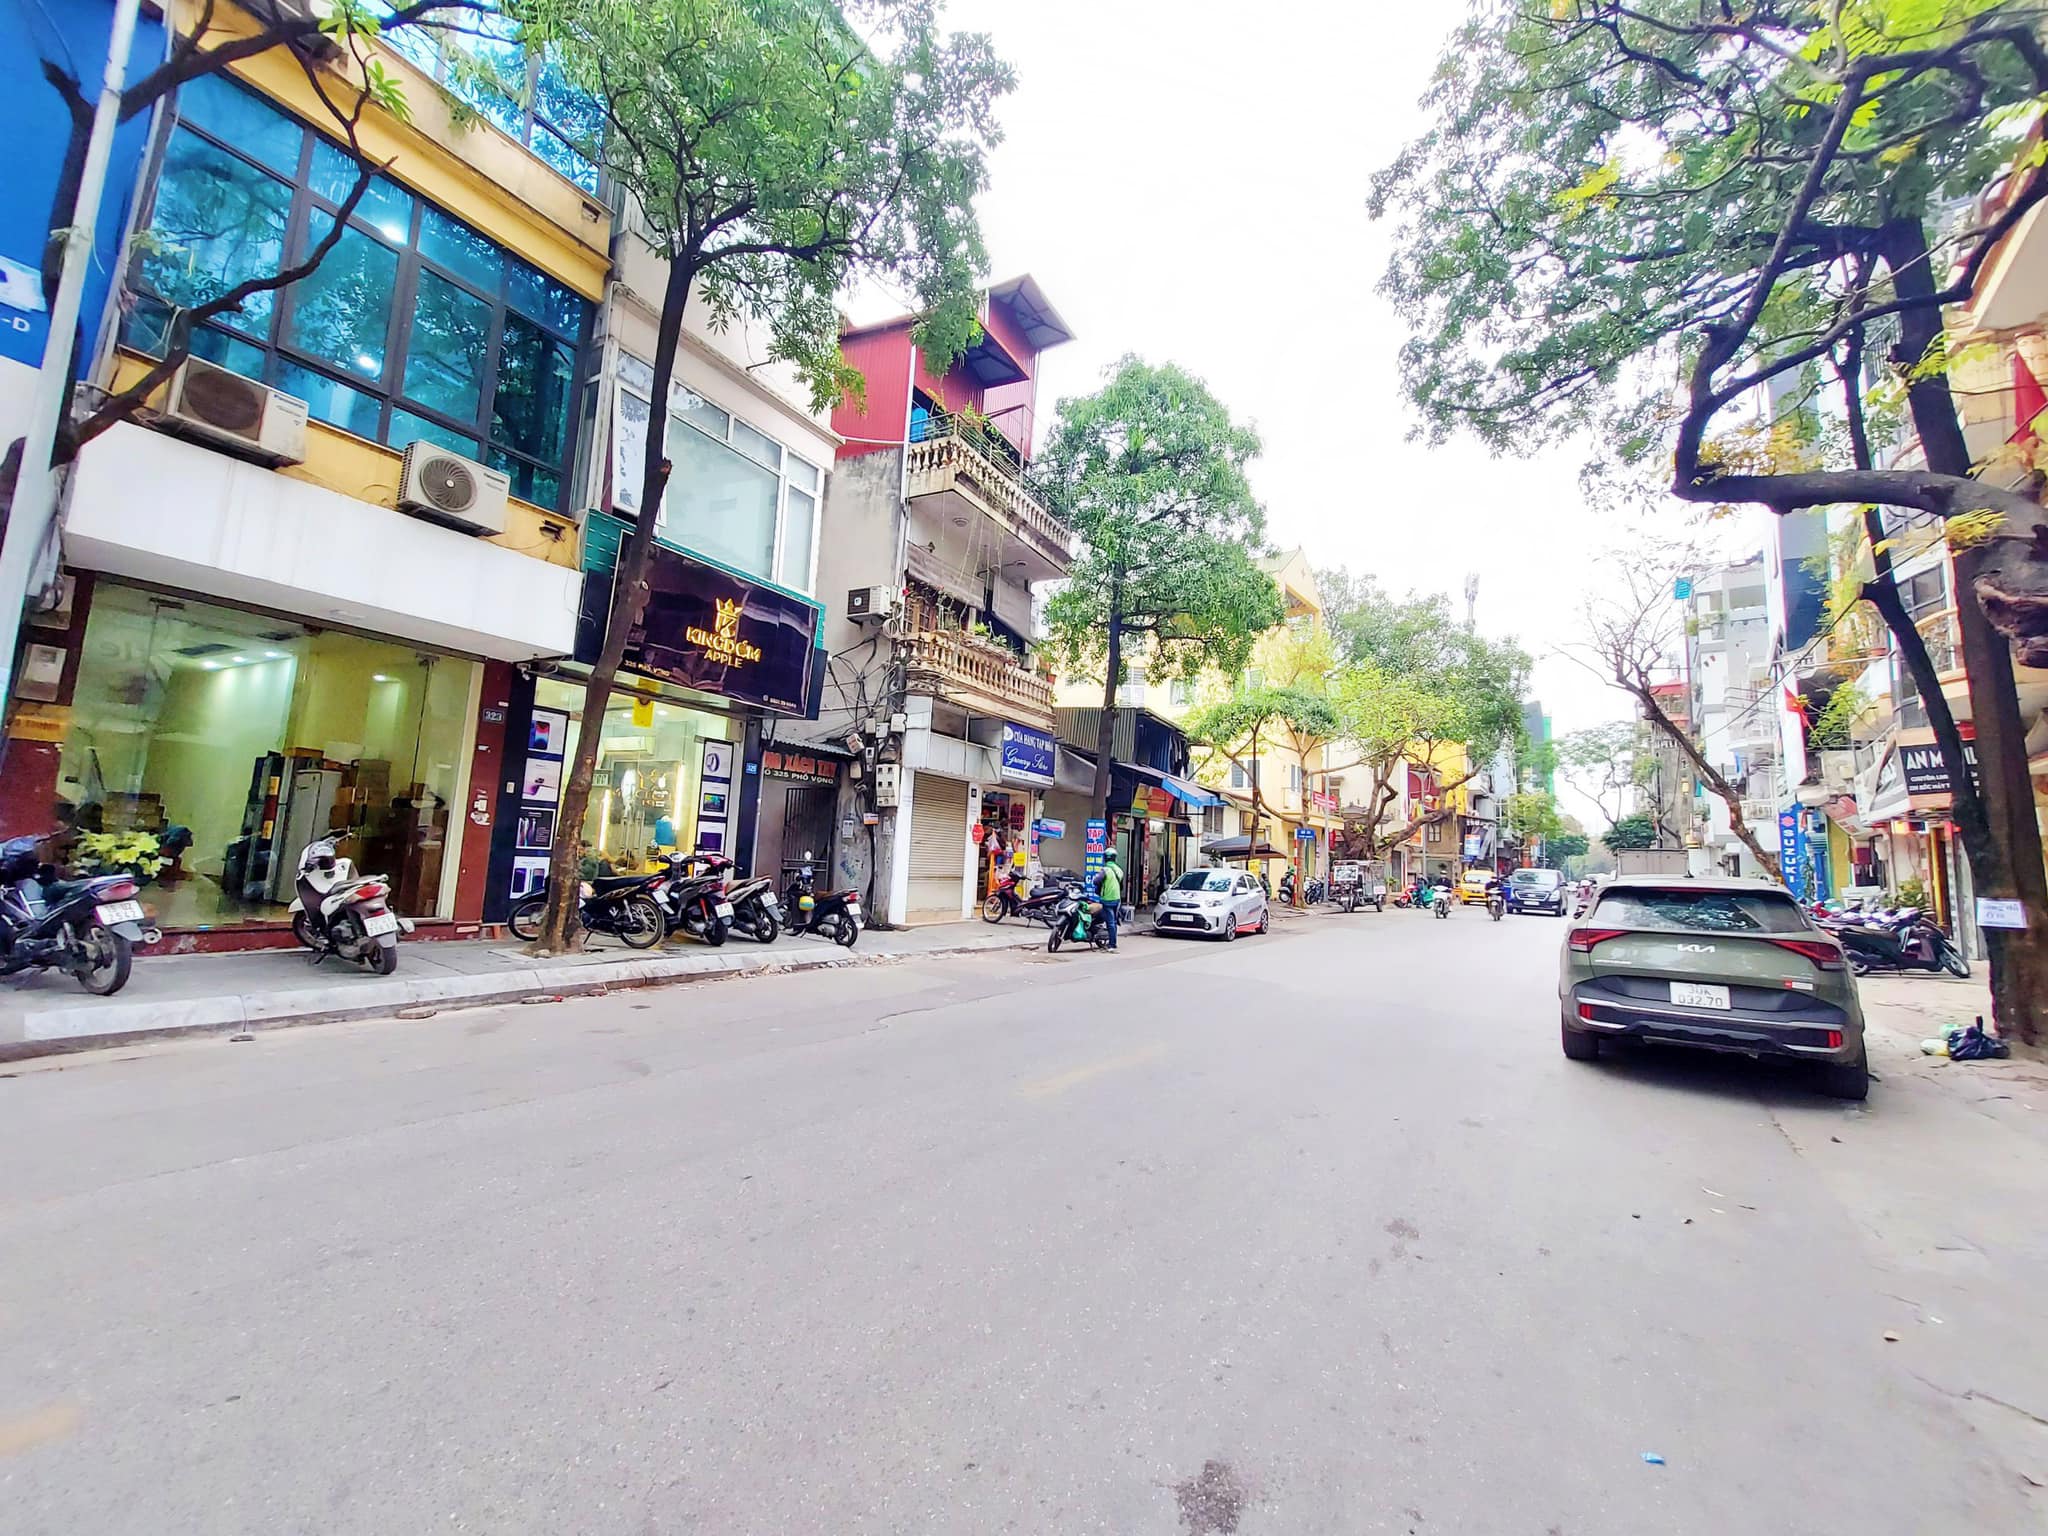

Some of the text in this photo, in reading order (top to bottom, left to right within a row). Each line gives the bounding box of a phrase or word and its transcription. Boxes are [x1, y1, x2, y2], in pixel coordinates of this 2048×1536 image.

[686, 626, 762, 662] KINGDOM
[704, 650, 743, 669] APPLE
[484, 709, 502, 722] 323
[1906, 750, 1928, 770] AN
[1783, 829, 1797, 883] SUZUKI
[1678, 943, 1716, 953] KIA
